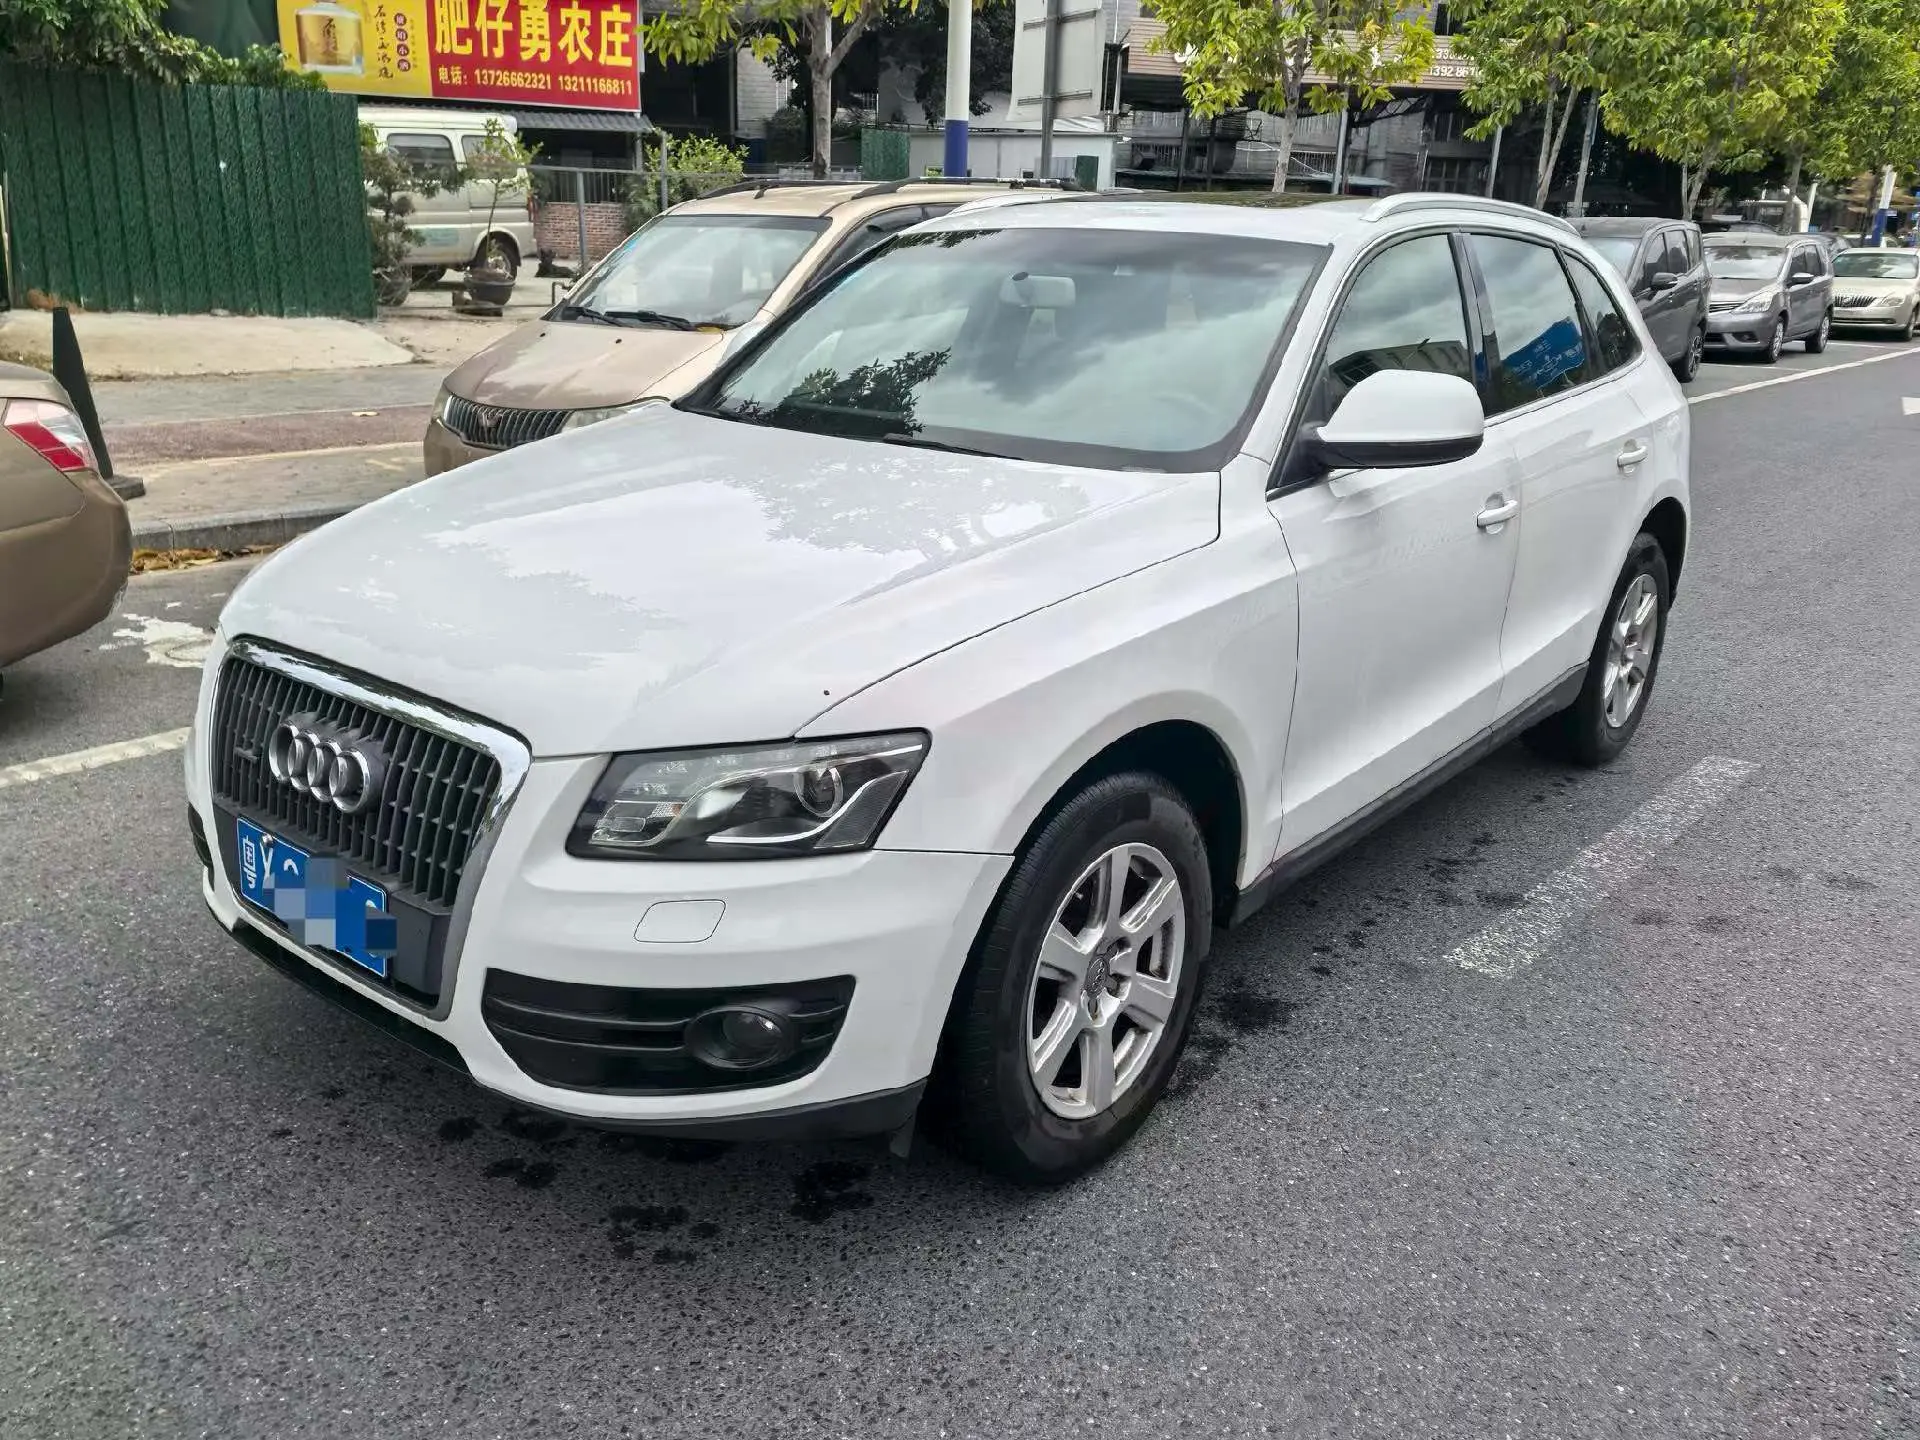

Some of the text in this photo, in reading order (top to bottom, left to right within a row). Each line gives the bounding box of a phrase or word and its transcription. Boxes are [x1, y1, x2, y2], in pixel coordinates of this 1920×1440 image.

[434, 0, 633, 67] 肥仔勇农庄
[474, 68, 551, 90] 13726662321
[558, 75, 632, 95] 13211166811
